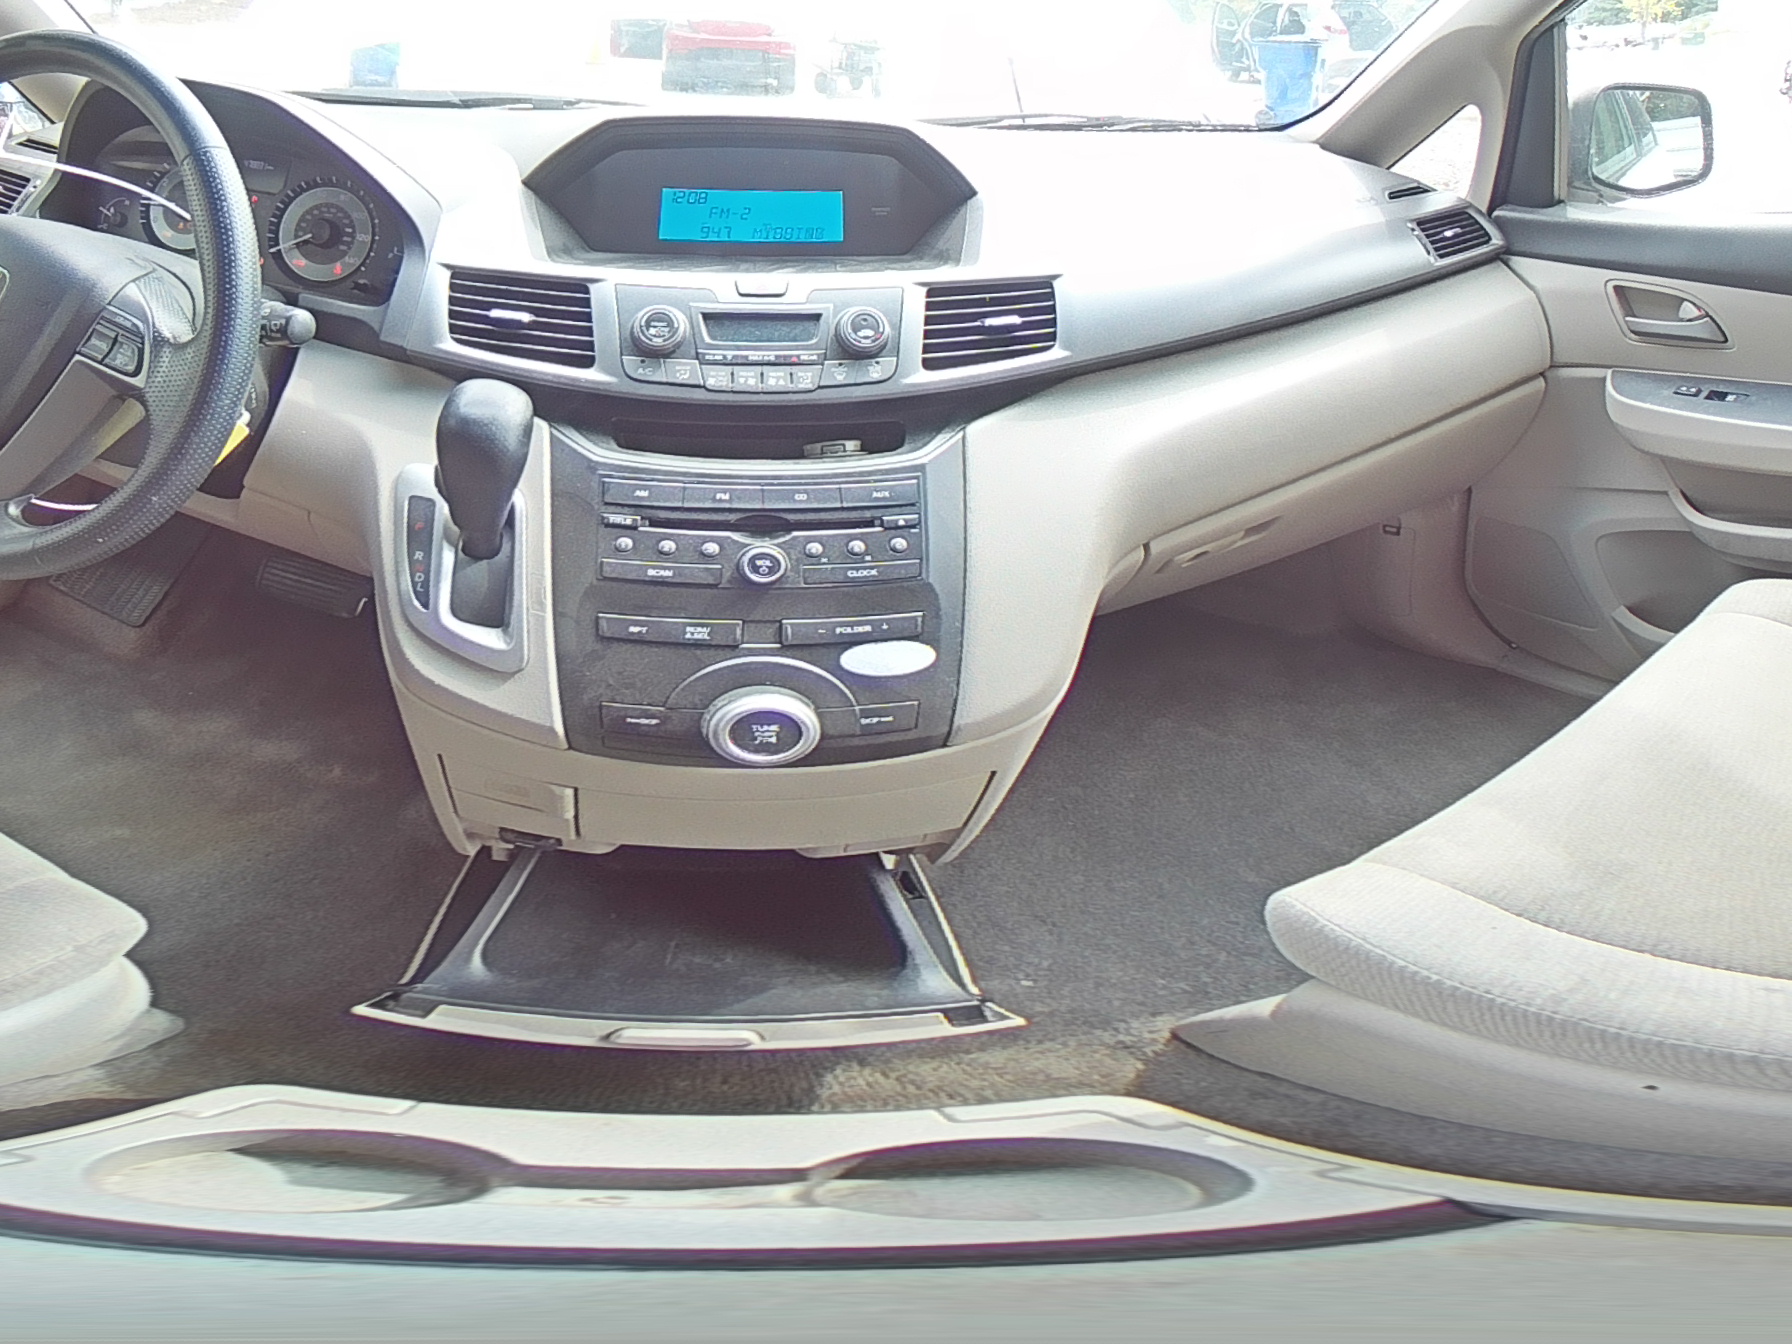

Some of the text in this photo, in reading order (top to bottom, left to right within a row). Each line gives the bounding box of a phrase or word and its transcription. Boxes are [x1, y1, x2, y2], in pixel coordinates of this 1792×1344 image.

[872, 490, 891, 498] AUX
[607, 516, 634, 526] TITLE
[413, 550, 425, 561] R
[754, 559, 774, 567] VOL
[414, 572, 425, 582] D
[646, 568, 674, 577] SCAN
[846, 568, 879, 577] CLOCK
[416, 582, 425, 592] L
[835, 624, 873, 635] FOLDER
